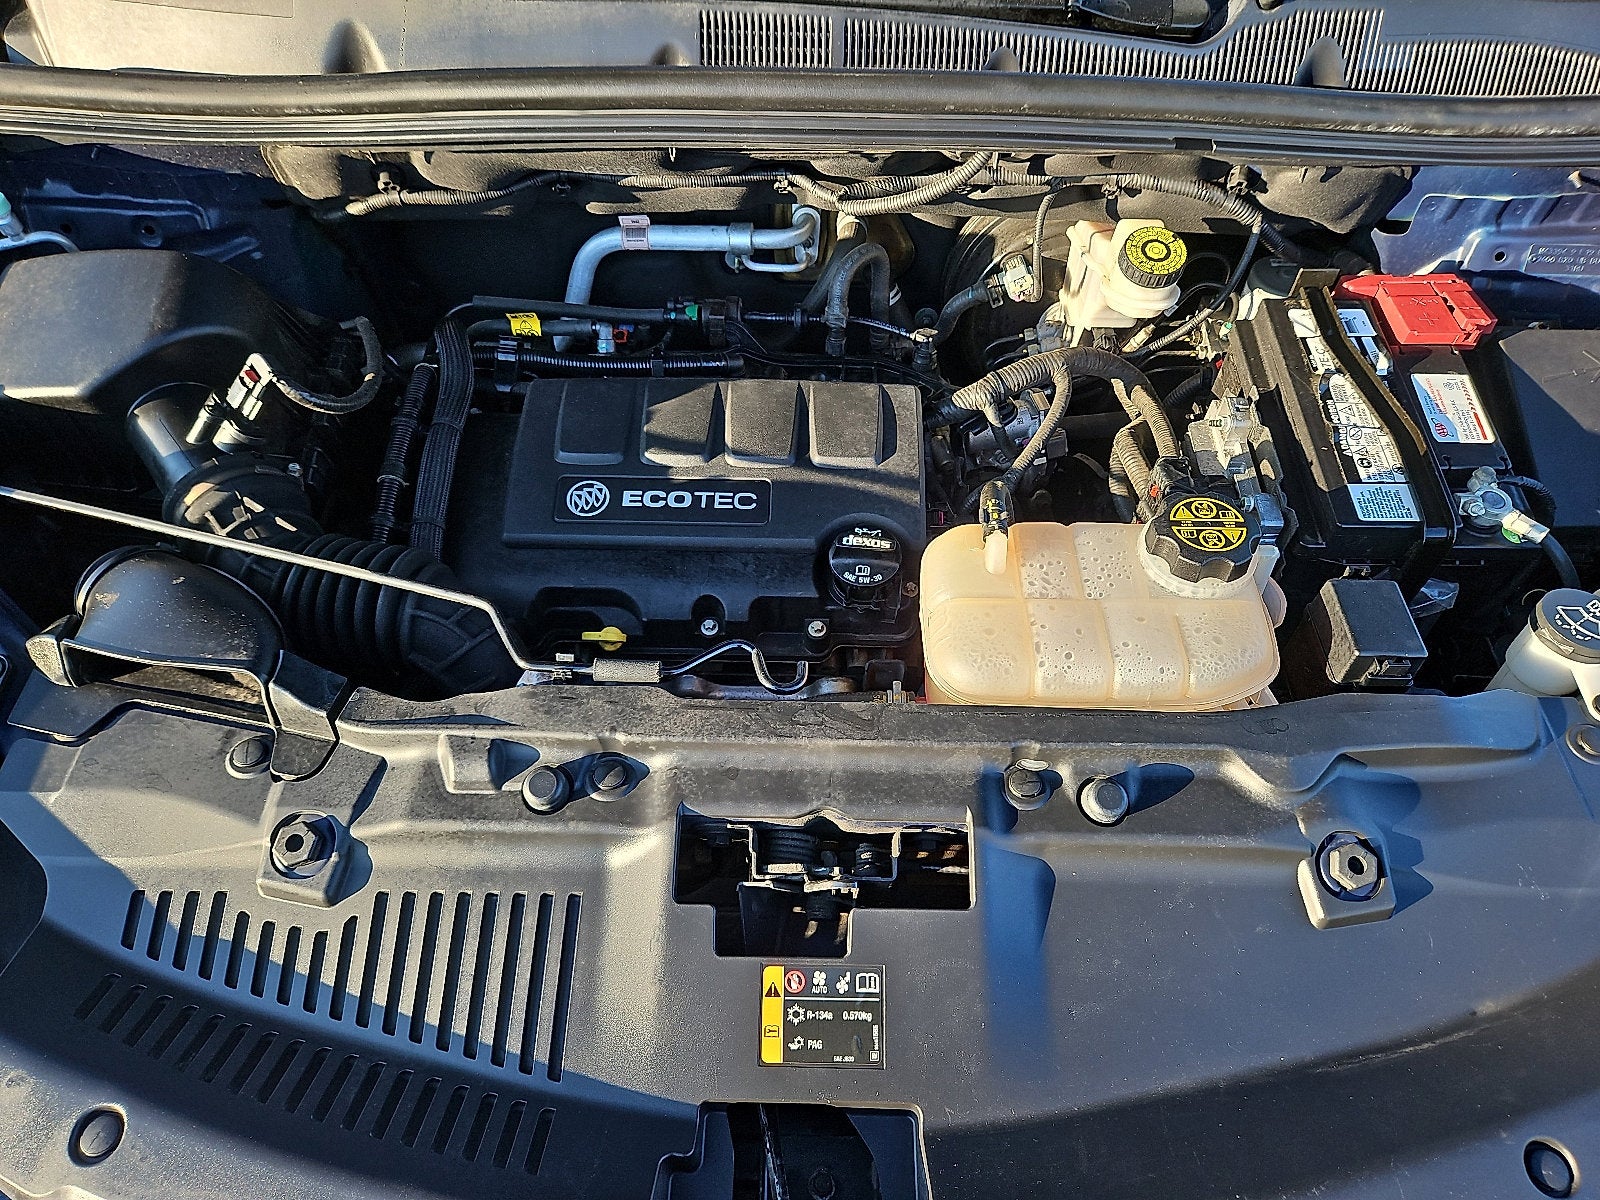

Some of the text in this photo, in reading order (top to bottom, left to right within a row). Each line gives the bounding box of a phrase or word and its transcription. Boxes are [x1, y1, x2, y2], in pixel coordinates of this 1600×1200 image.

[621, 490, 758, 510] ECOTEC
[842, 534, 892, 549] dexos
[843, 571, 883, 584] SAE 5W-30
[811, 985, 828, 994] AUTO
[806, 1010, 834, 1020] R-134a
[807, 1039, 823, 1050] PAG
